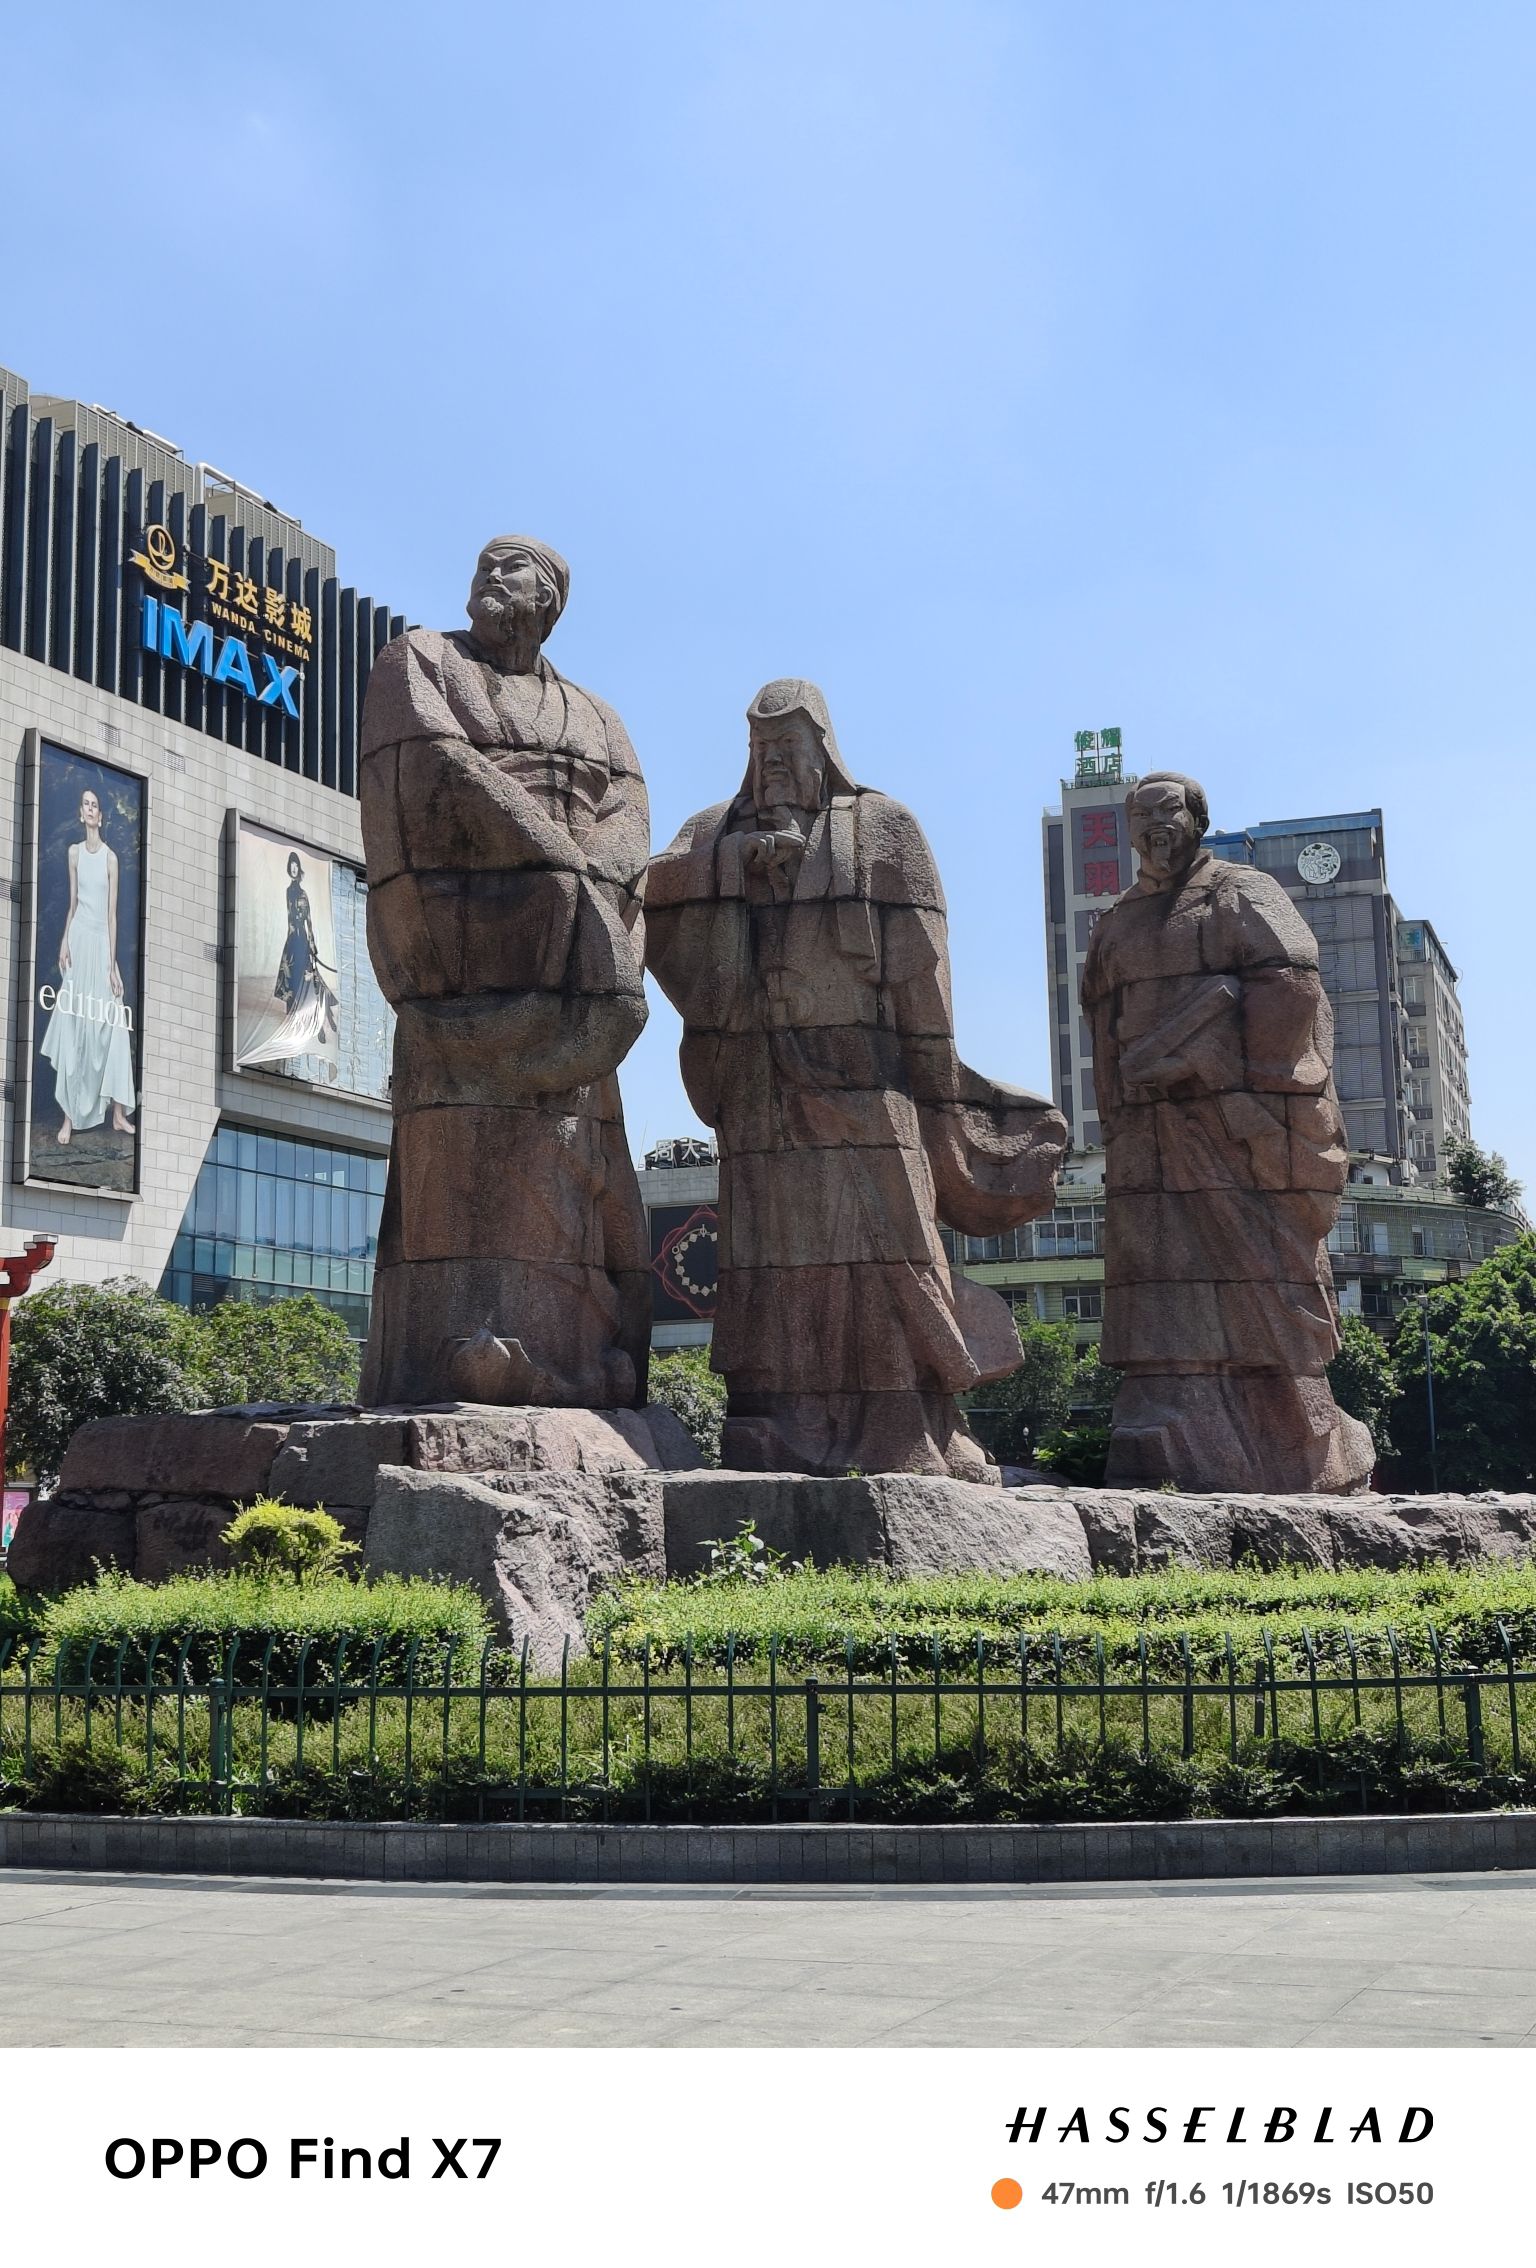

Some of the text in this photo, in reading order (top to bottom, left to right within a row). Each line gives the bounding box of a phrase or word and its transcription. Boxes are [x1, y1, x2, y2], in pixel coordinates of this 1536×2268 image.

[205, 557, 312, 643] 万达影城
[211, 601, 310, 661] WANDA CINEMA
[143, 594, 300, 720] IMAX
[1075, 753, 1122, 776] 酒店
[1082, 811, 1120, 897] 天羽
